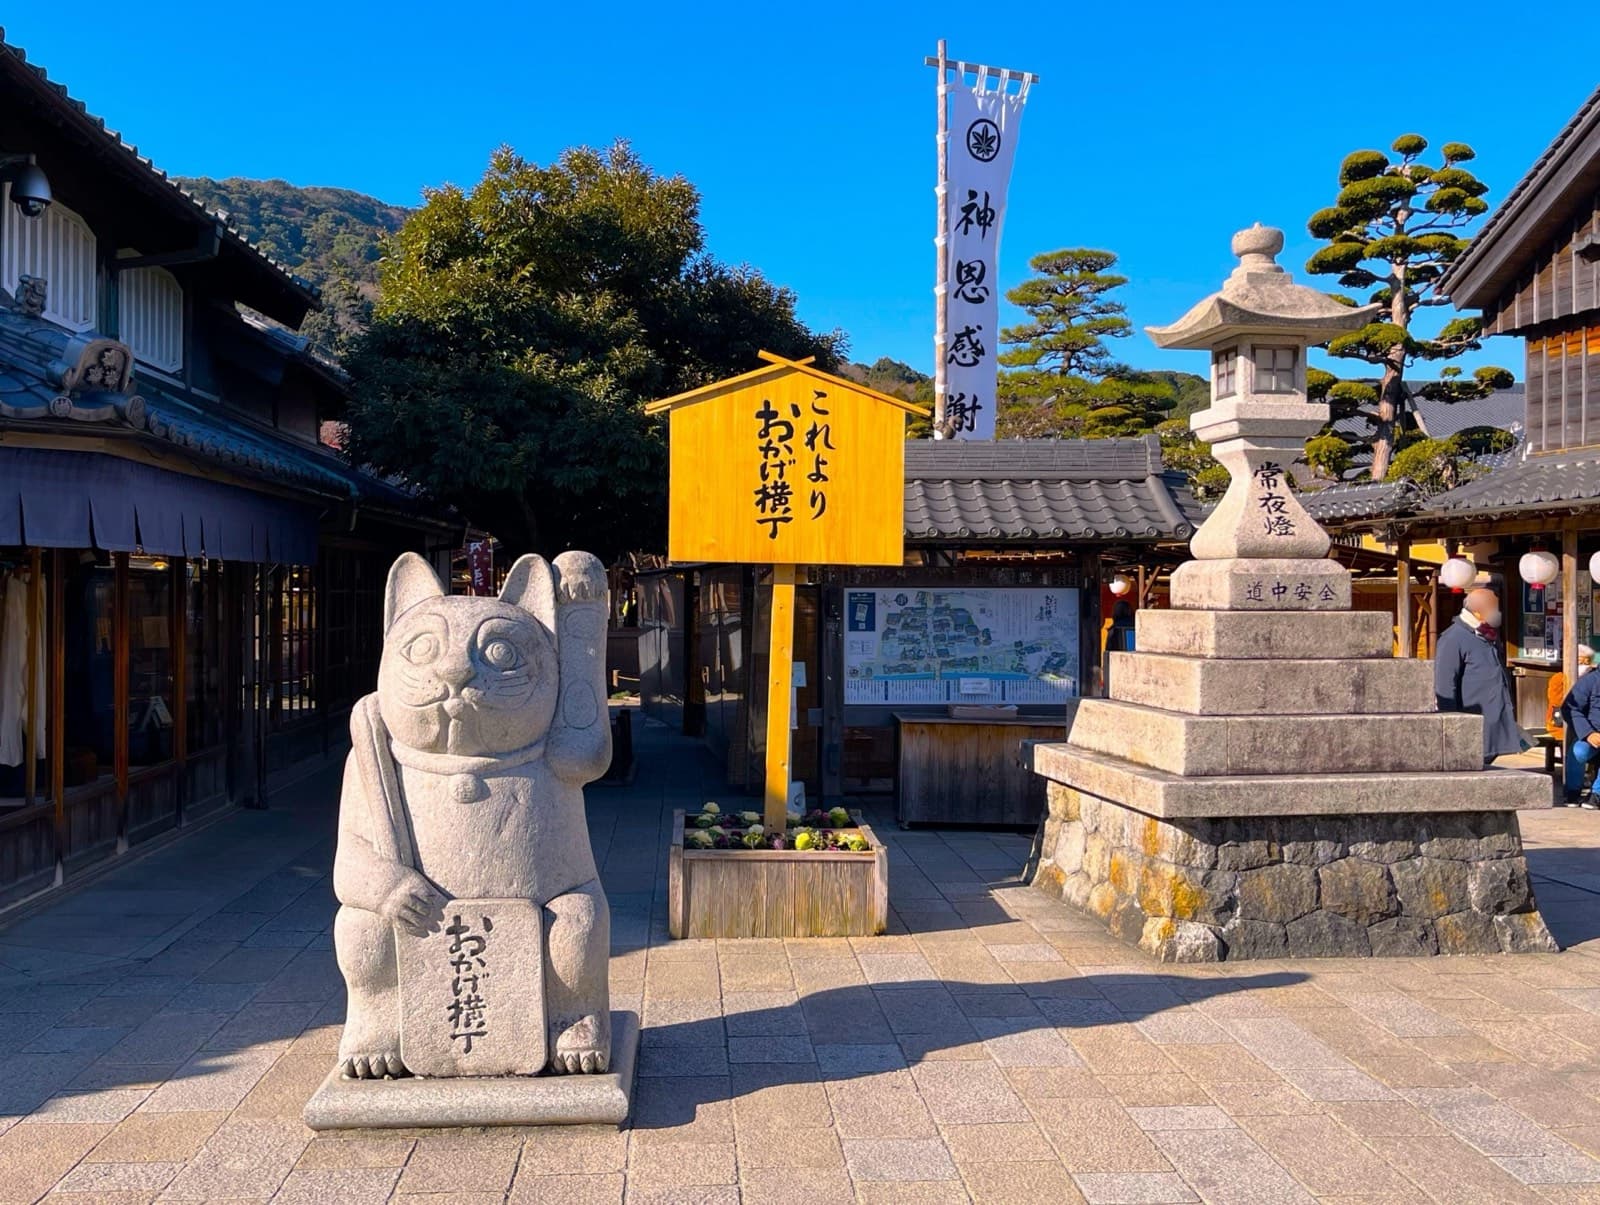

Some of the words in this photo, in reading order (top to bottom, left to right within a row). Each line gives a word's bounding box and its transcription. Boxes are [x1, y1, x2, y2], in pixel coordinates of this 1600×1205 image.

[946, 189, 996, 432] 神恩感謝
[753, 399, 802, 540] おかげ横丁
[804, 389, 837, 521] これより
[1253, 461, 1297, 537] 常夜燈
[1246, 581, 1337, 602] 道中安全
[446, 914, 494, 1055] おかげ横丁
